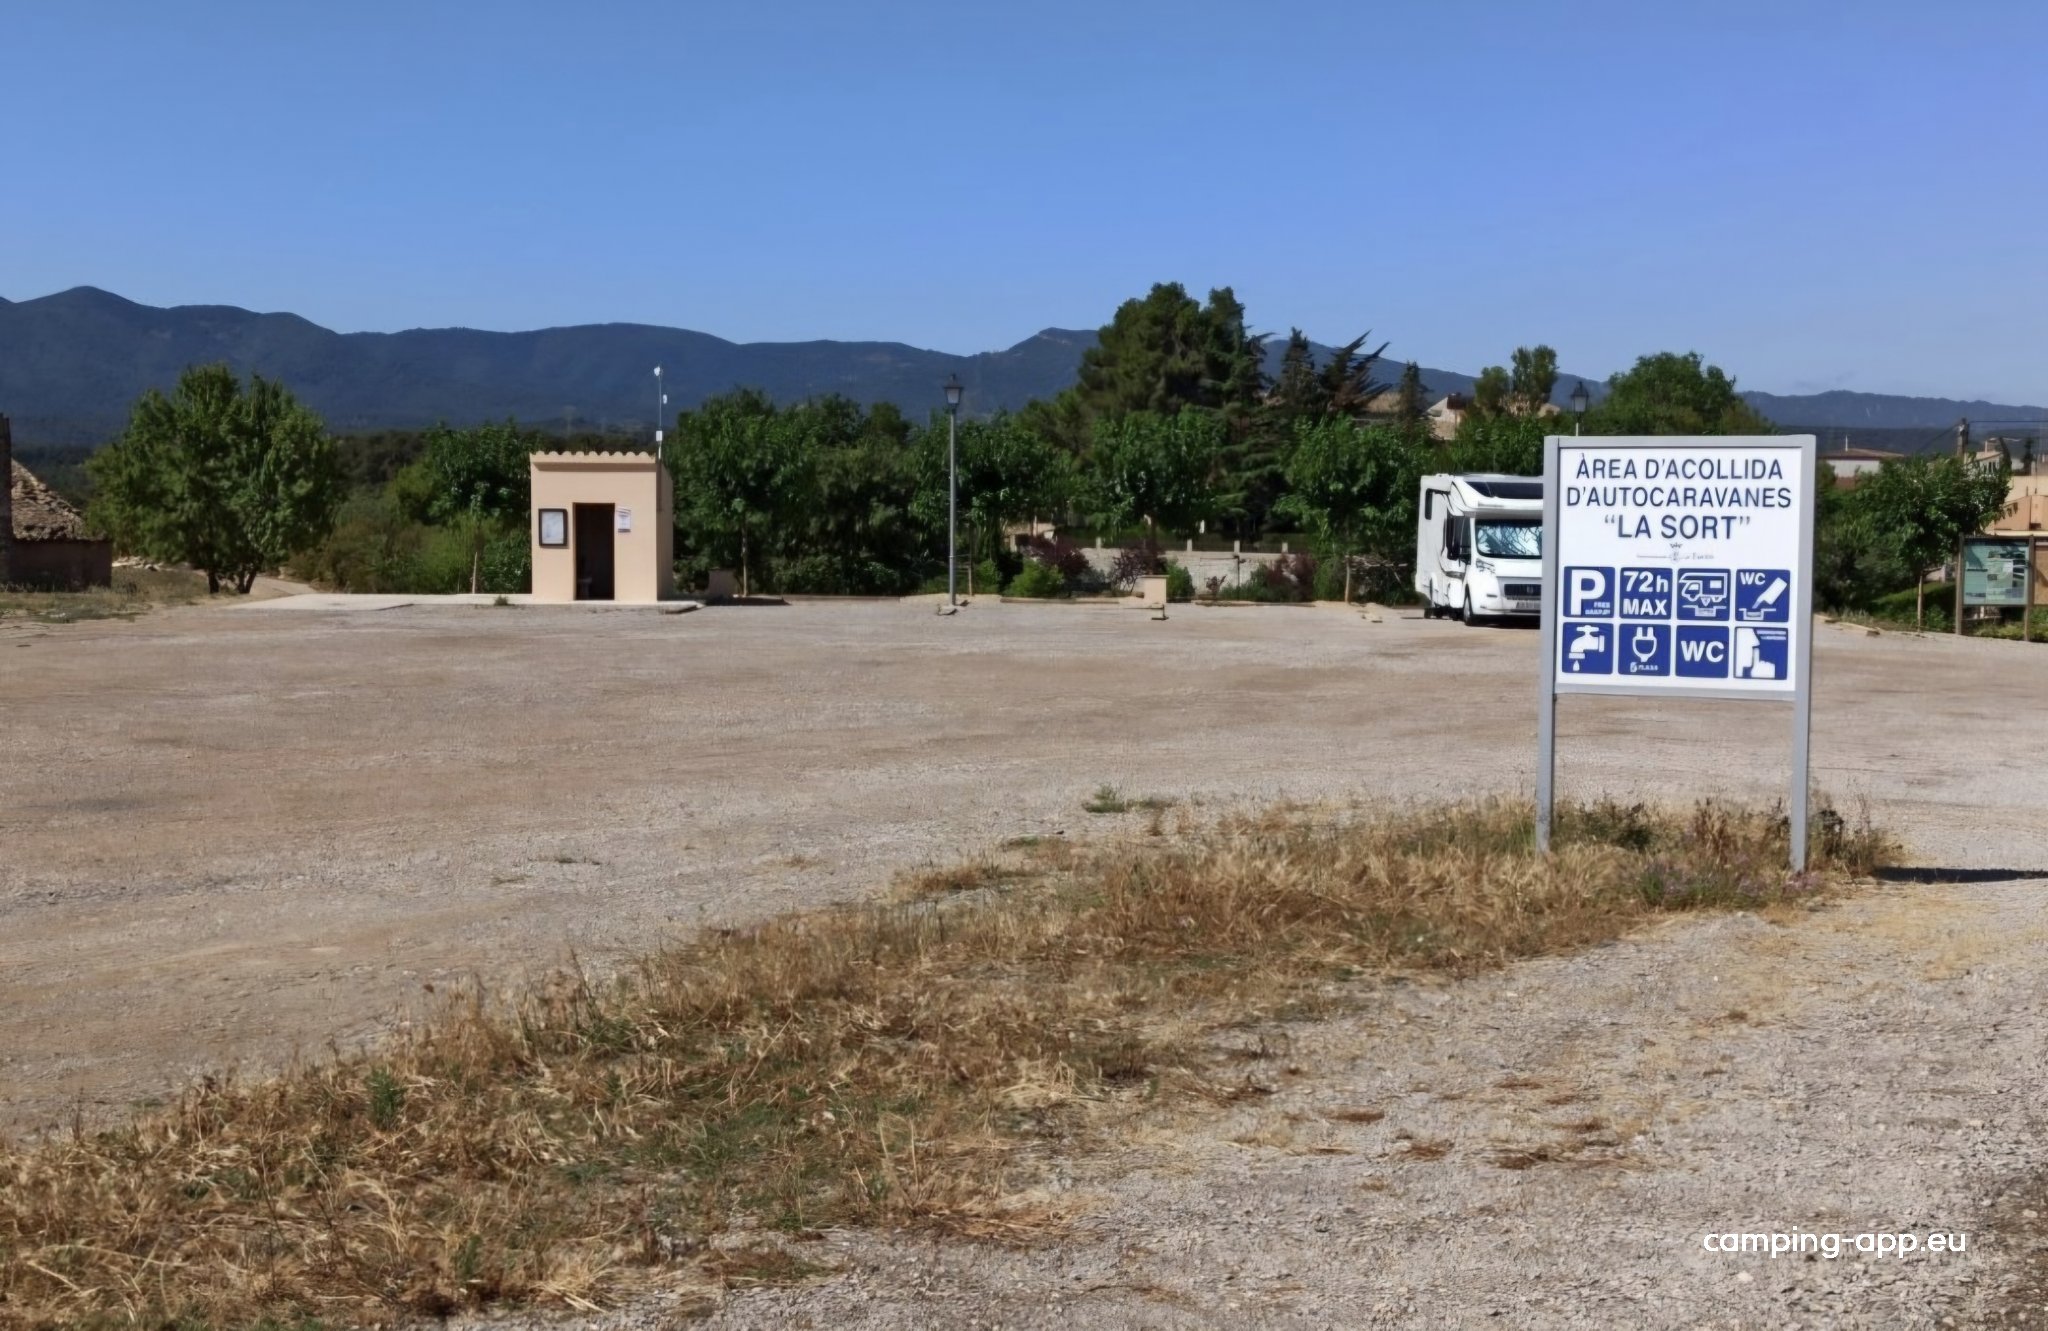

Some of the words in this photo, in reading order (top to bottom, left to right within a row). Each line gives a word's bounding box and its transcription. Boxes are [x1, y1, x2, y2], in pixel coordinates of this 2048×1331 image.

[1575, 453, 1638, 480] ÀREA
[1645, 458, 1783, 480] D'ACOLLIDA
[1566, 486, 1792, 509] D'AUTOCARAVANES
[1623, 570, 1669, 593] 72h
[1740, 572, 1766, 586] WC
[1570, 569, 1606, 616] P
[1623, 598, 1667, 616] MAX
[1681, 640, 1725, 663] WC
